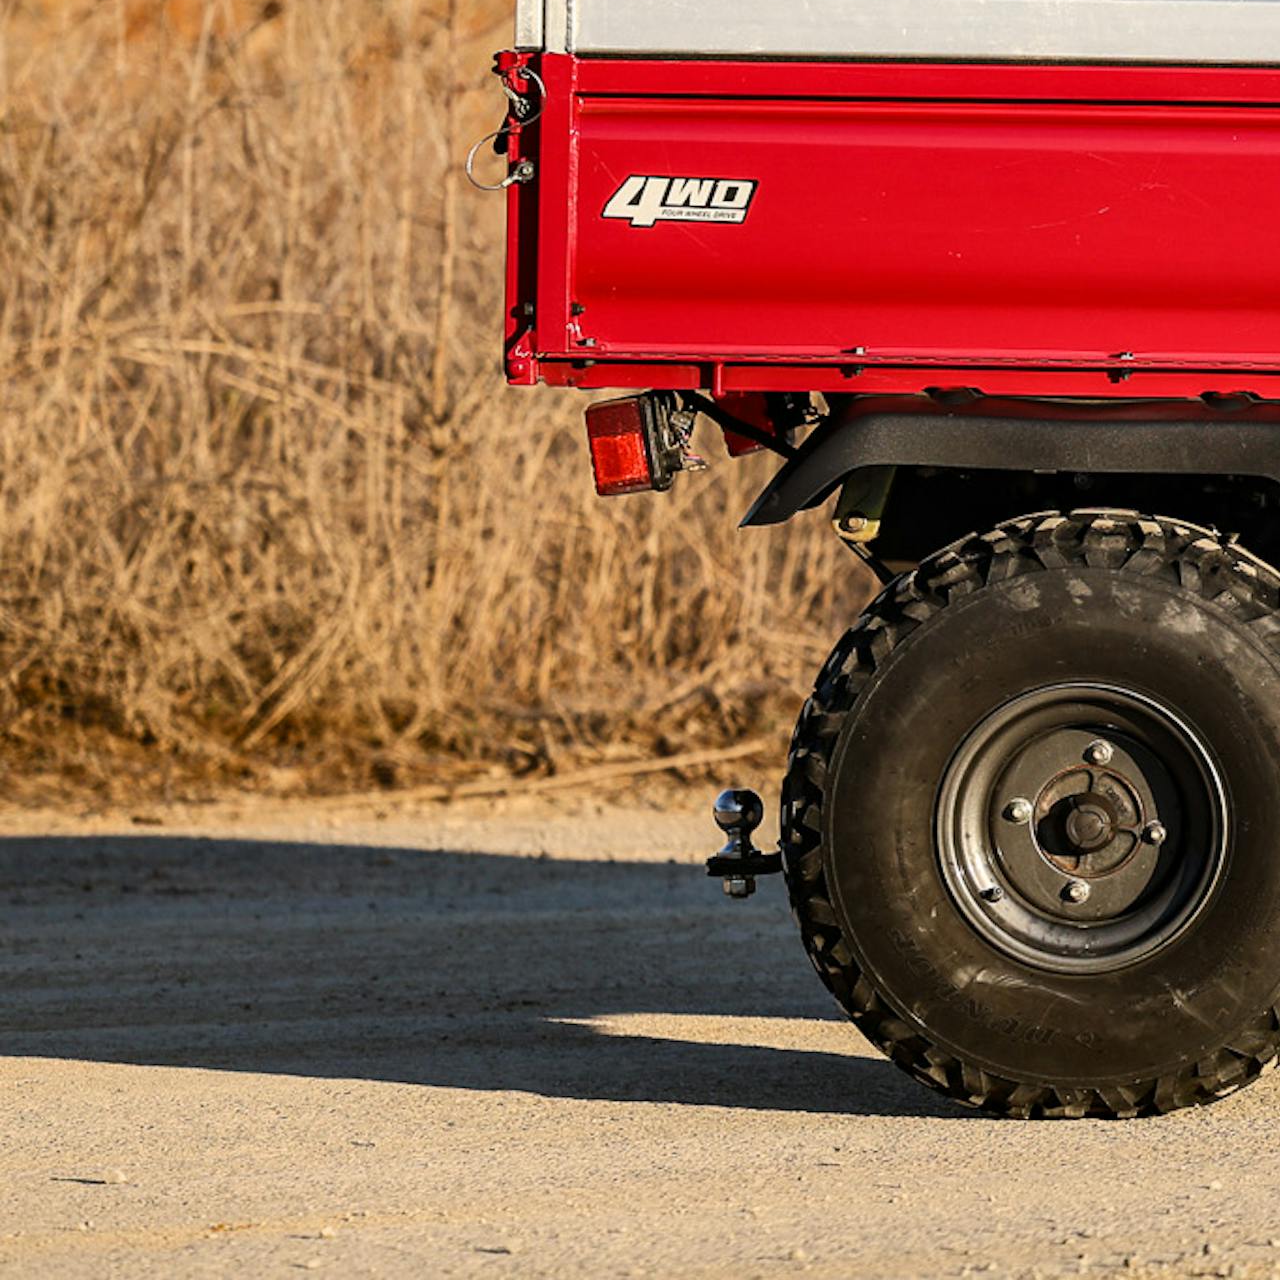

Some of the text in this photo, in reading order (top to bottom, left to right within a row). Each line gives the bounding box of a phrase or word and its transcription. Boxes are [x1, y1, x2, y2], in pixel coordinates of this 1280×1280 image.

[602, 176, 755, 227] 4WD
[661, 209, 737, 219] FOUR WHEEL DRIVE
